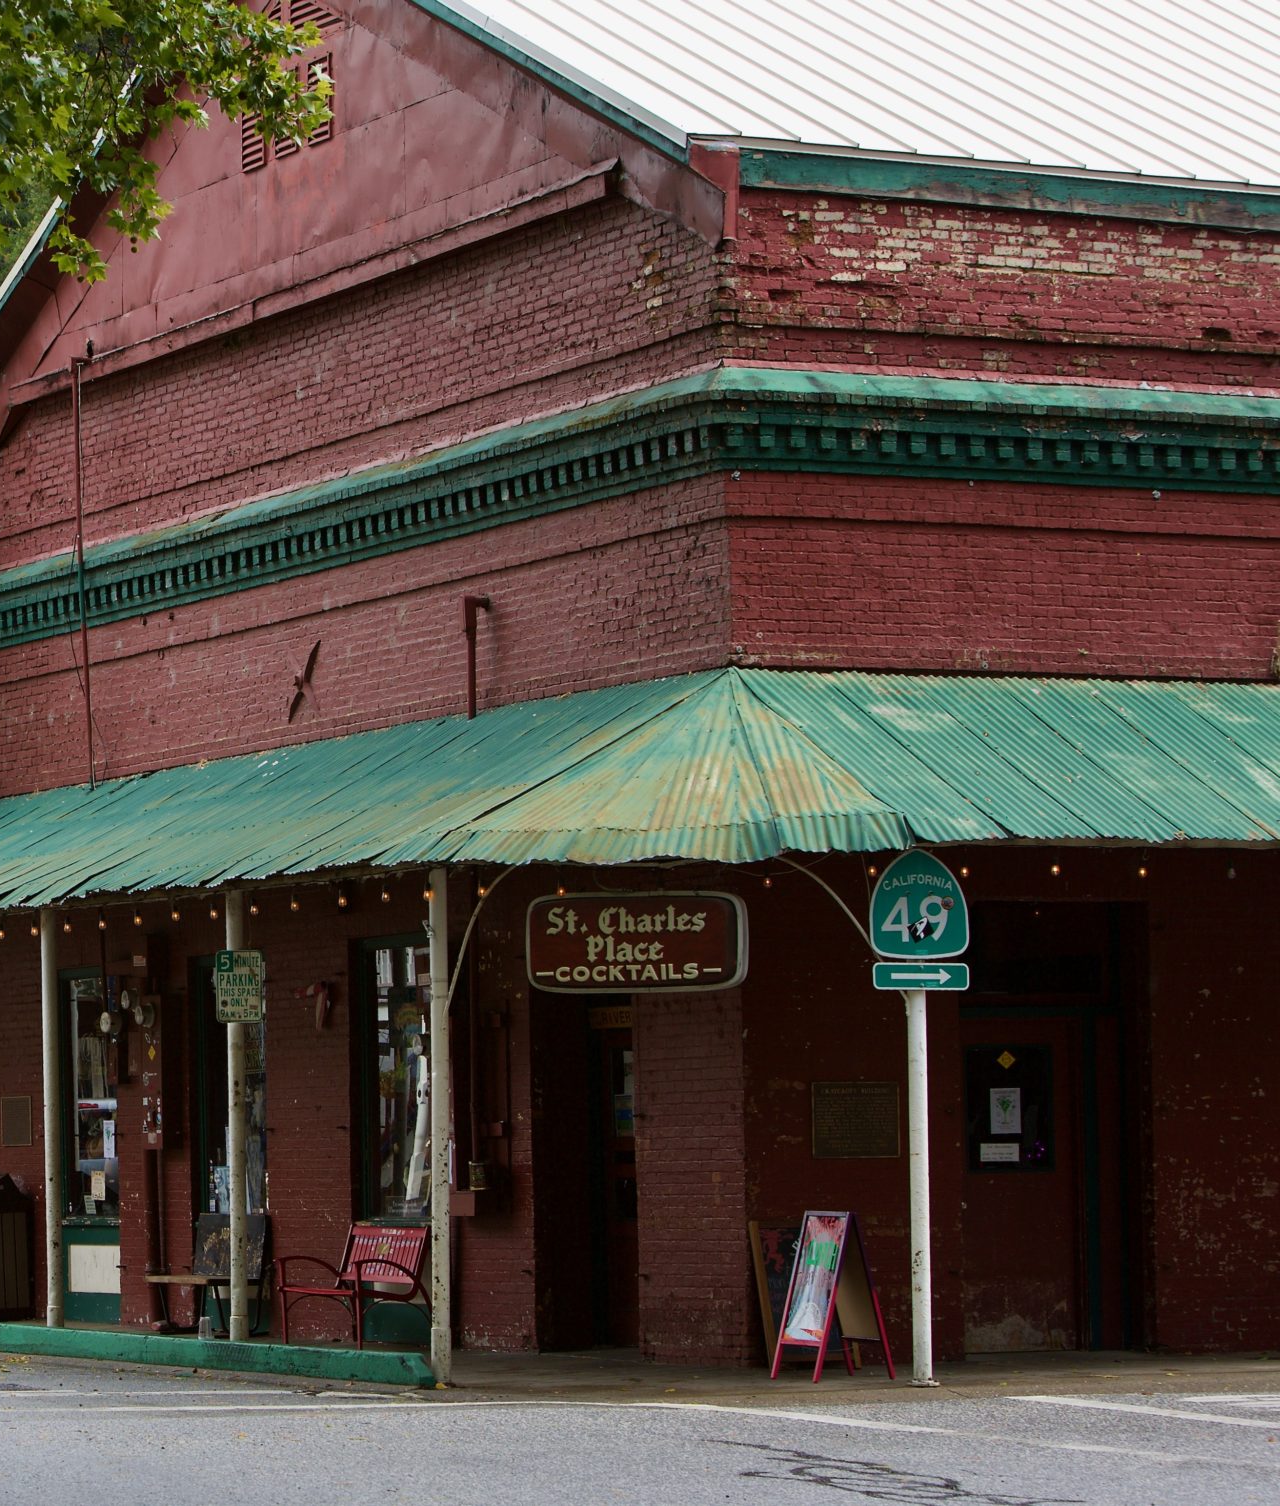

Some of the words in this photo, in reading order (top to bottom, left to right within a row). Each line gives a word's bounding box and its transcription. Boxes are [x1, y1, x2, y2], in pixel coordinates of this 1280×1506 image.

[882, 874, 953, 891] CALIFORNIA
[546, 906, 588, 935] St.
[598, 904, 707, 935] Charles
[881, 895, 949, 942] 49
[585, 934, 664, 963] Place
[220, 955, 230, 970] 5
[234, 956, 259, 967] MINUTE
[219, 973, 259, 987] PARKING
[555, 963, 699, 982] COCKTAILS
[219, 987, 235, 997] THIS
[237, 987, 259, 997] SPACE
[230, 998, 248, 1007] ONLY
